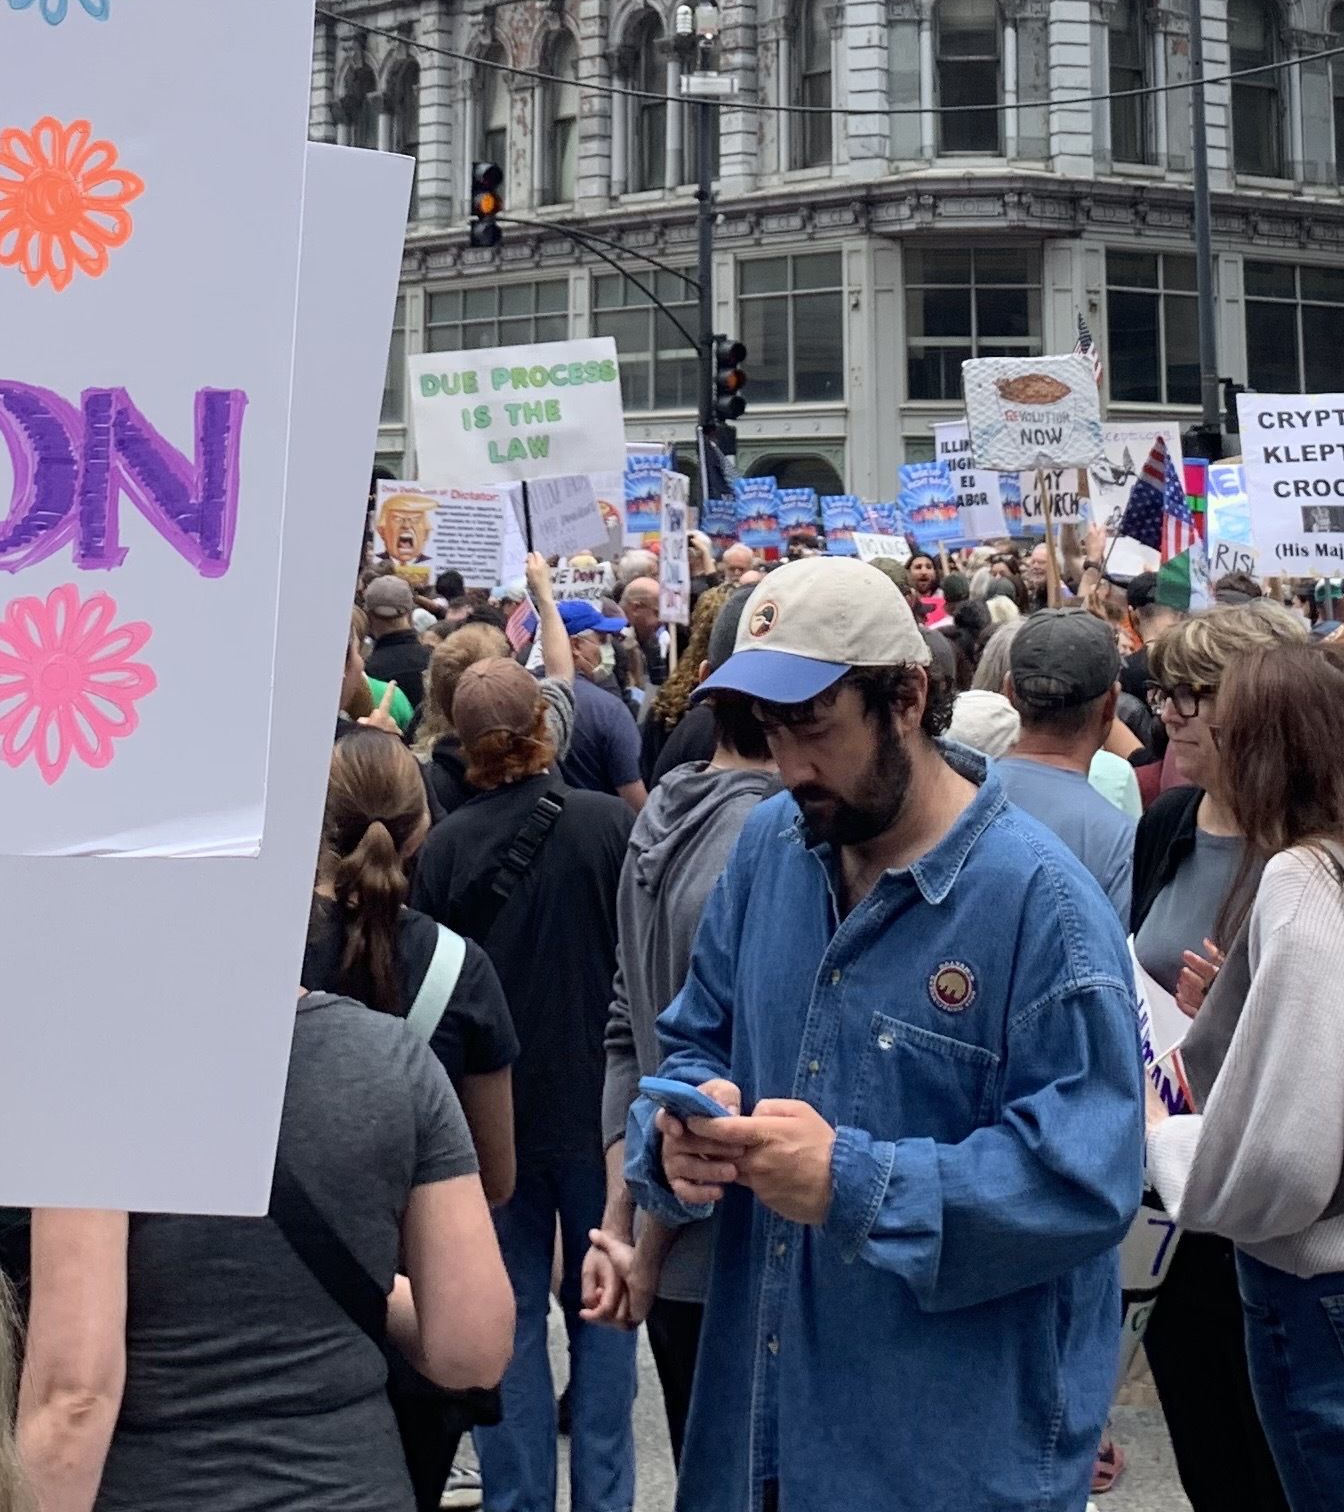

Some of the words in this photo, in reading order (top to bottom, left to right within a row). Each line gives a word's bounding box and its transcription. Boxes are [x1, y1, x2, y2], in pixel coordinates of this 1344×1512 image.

[420, 370, 479, 397] DUE
[490, 359, 617, 391] PROCESS
[461, 405, 492, 431] IS
[505, 399, 562, 427] THE
[1020, 427, 1063, 446] NOW
[487, 435, 551, 464] LAW
[957, 492, 989, 508] ABOR
[1275, 543, 1309, 561] (His
